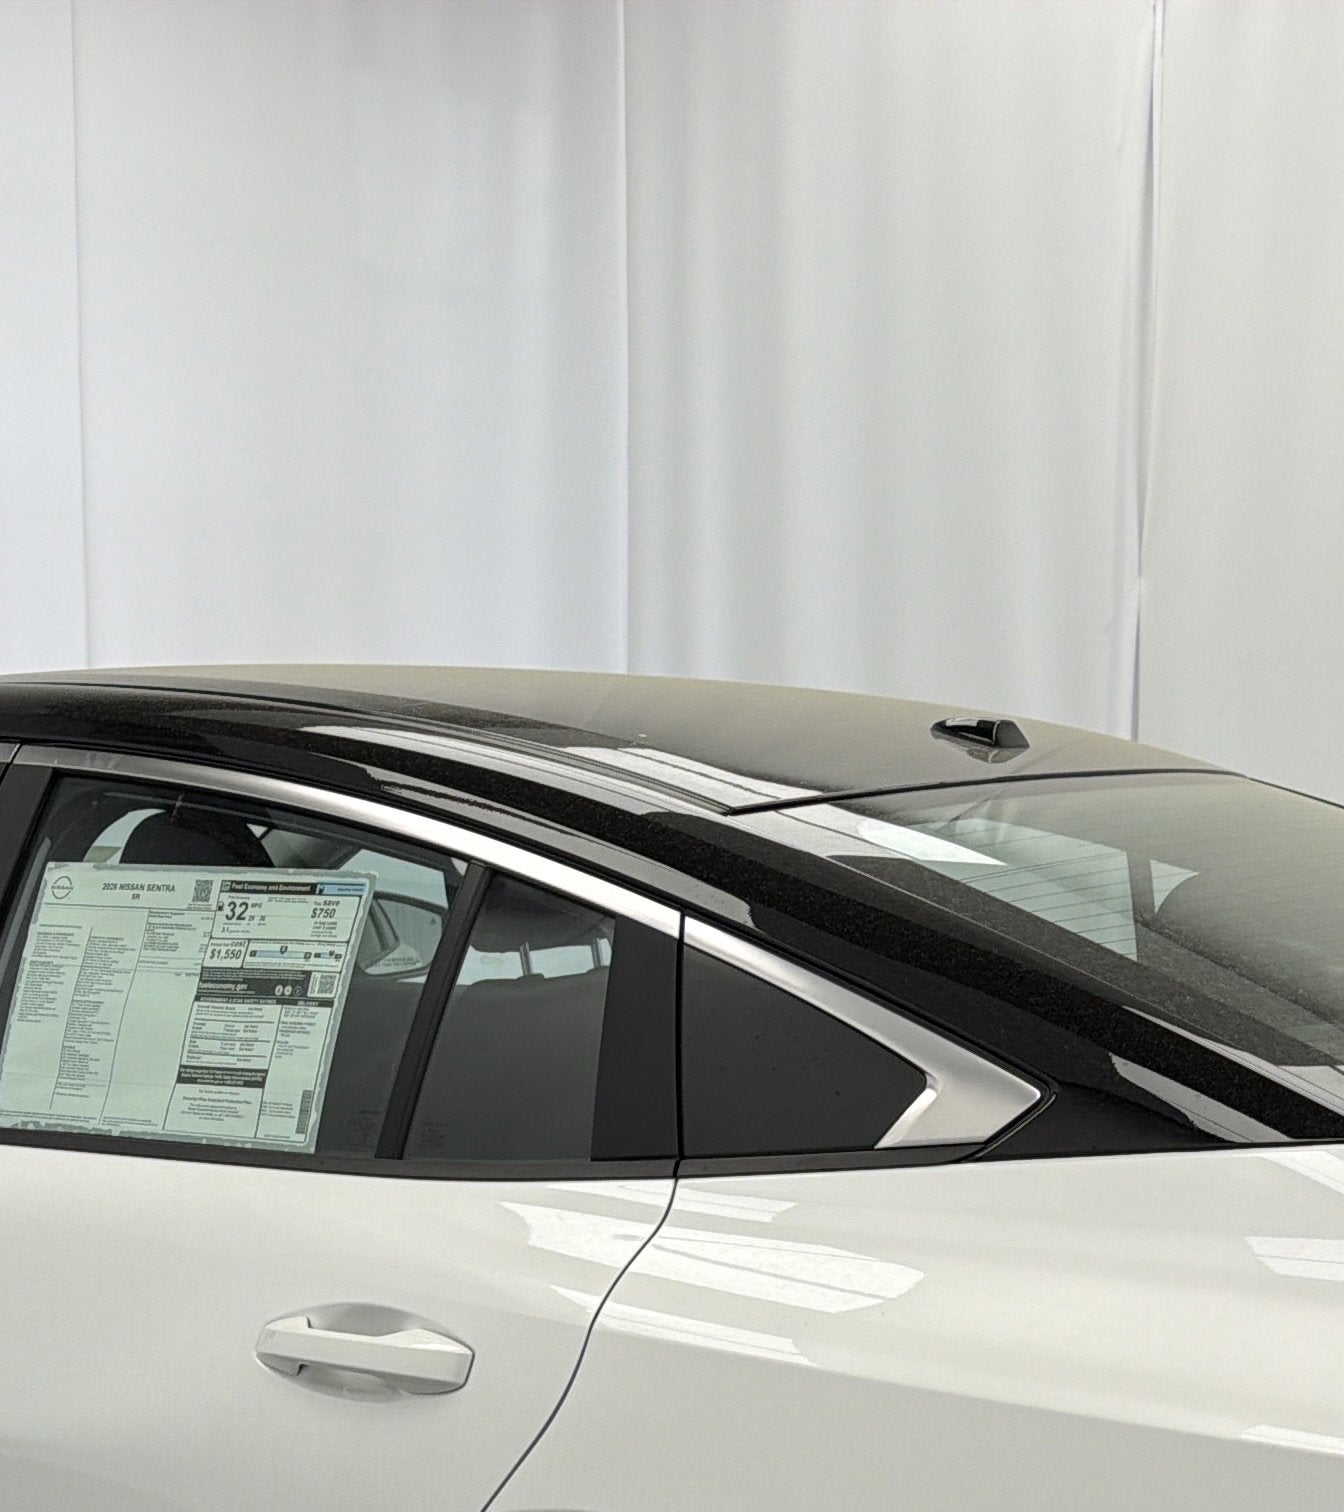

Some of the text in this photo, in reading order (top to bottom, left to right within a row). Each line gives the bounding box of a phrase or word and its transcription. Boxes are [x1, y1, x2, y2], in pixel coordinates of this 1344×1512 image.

[119, 883, 145, 891] NISSAN
[146, 883, 176, 893] SENTRA
[225, 901, 249, 921] 32
[311, 907, 337, 919] $750
[209, 948, 243, 961] $1,550
